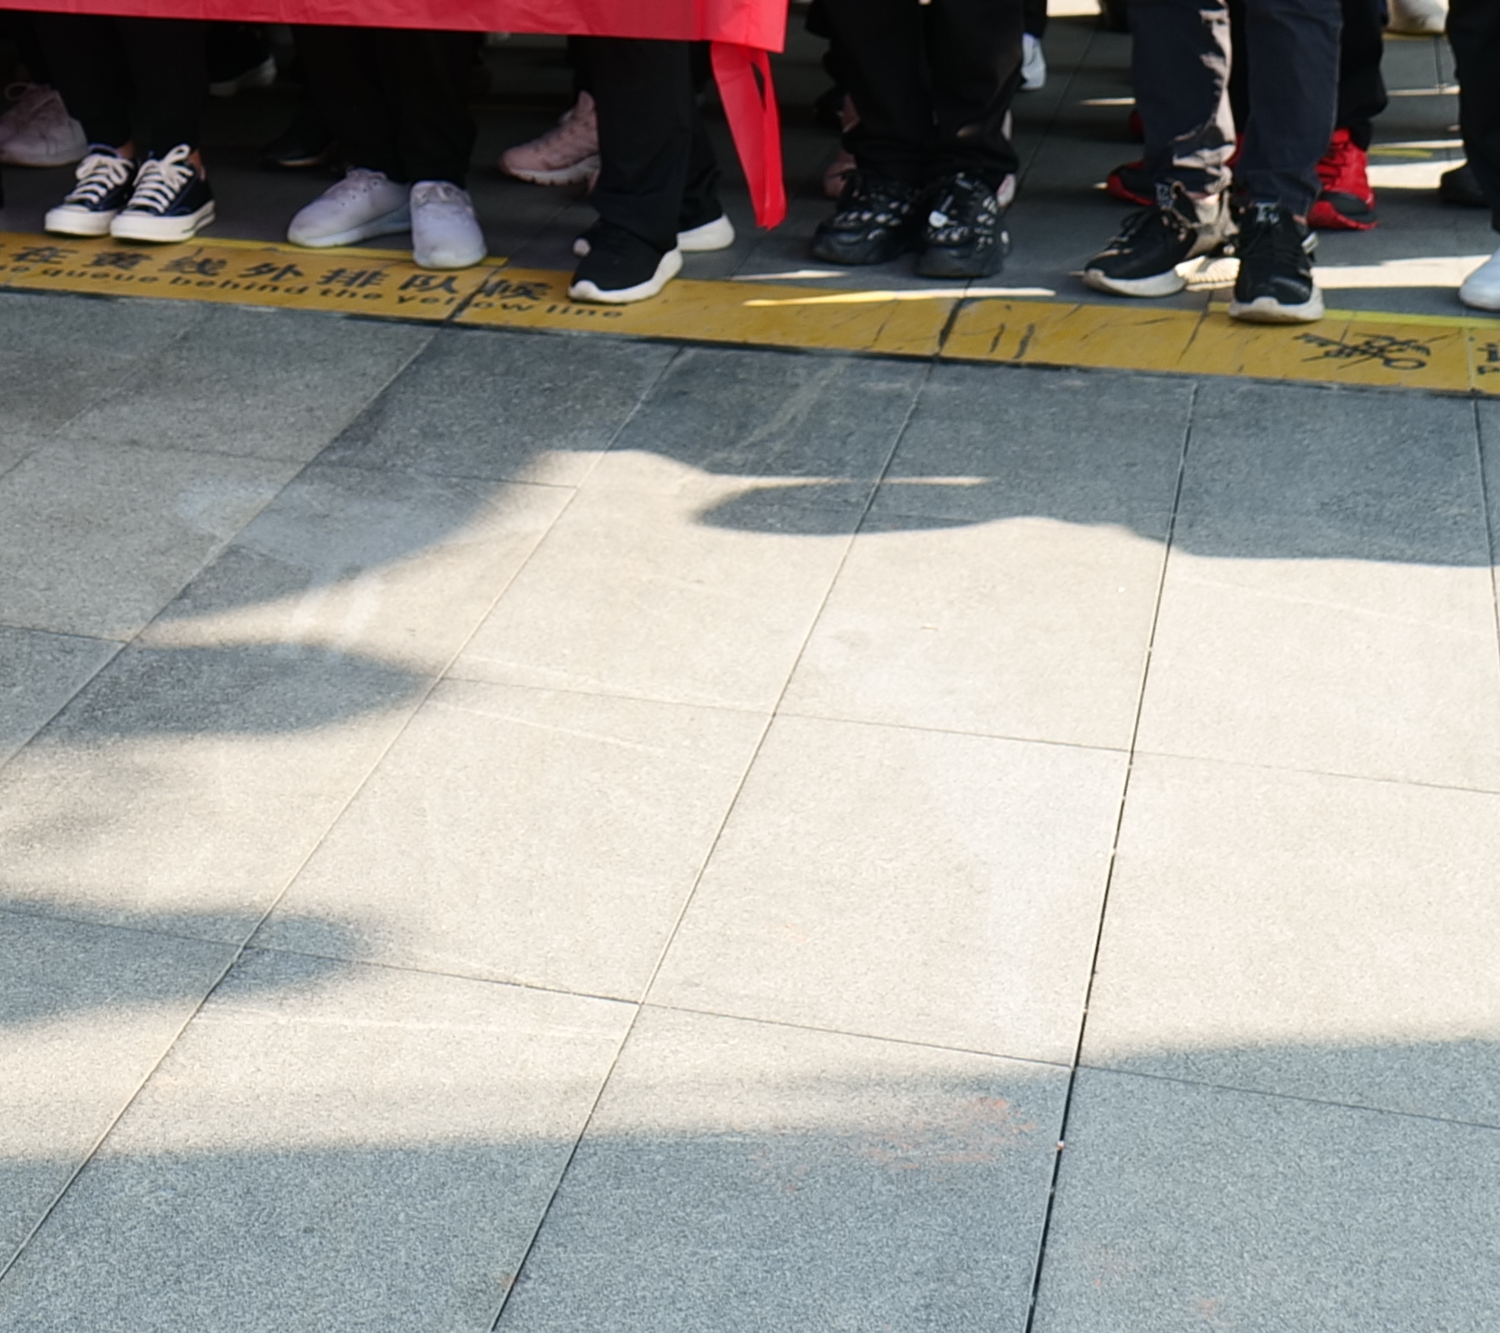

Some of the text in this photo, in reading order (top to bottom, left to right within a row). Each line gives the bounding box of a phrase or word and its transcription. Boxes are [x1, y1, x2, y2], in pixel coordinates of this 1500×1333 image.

[39, 266, 158, 284] queue
[168, 276, 310, 295] behind
[319, 286, 383, 302] the
[395, 293, 535, 314] yellow
[545, 303, 624, 318] line
